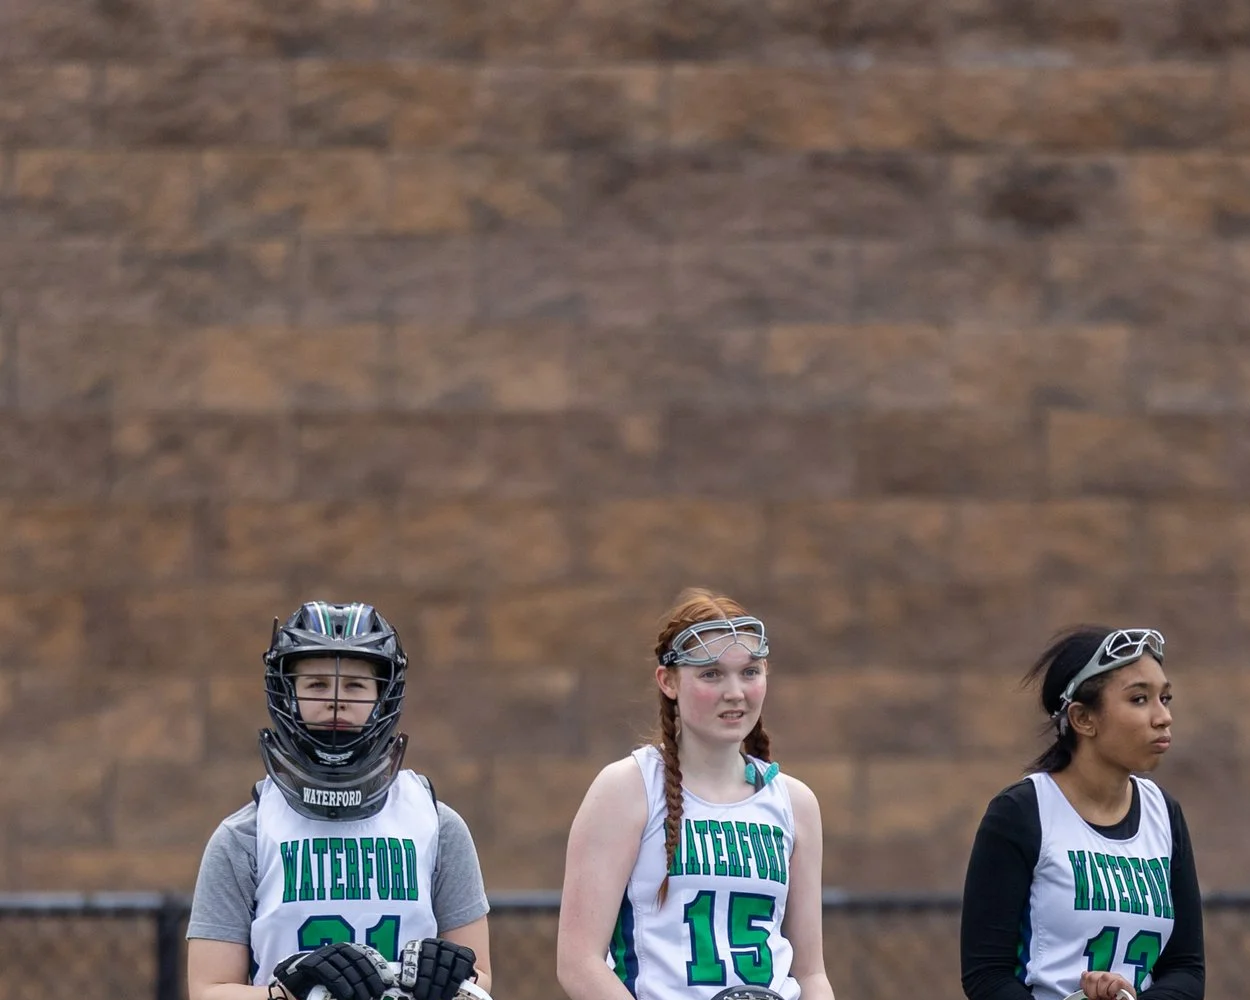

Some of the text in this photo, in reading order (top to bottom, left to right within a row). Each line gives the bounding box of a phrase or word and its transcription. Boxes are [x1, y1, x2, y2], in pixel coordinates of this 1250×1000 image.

[303, 787, 361, 807] WATERFORD
[281, 838, 418, 902] WATERFORD
[683, 890, 777, 987] 15
